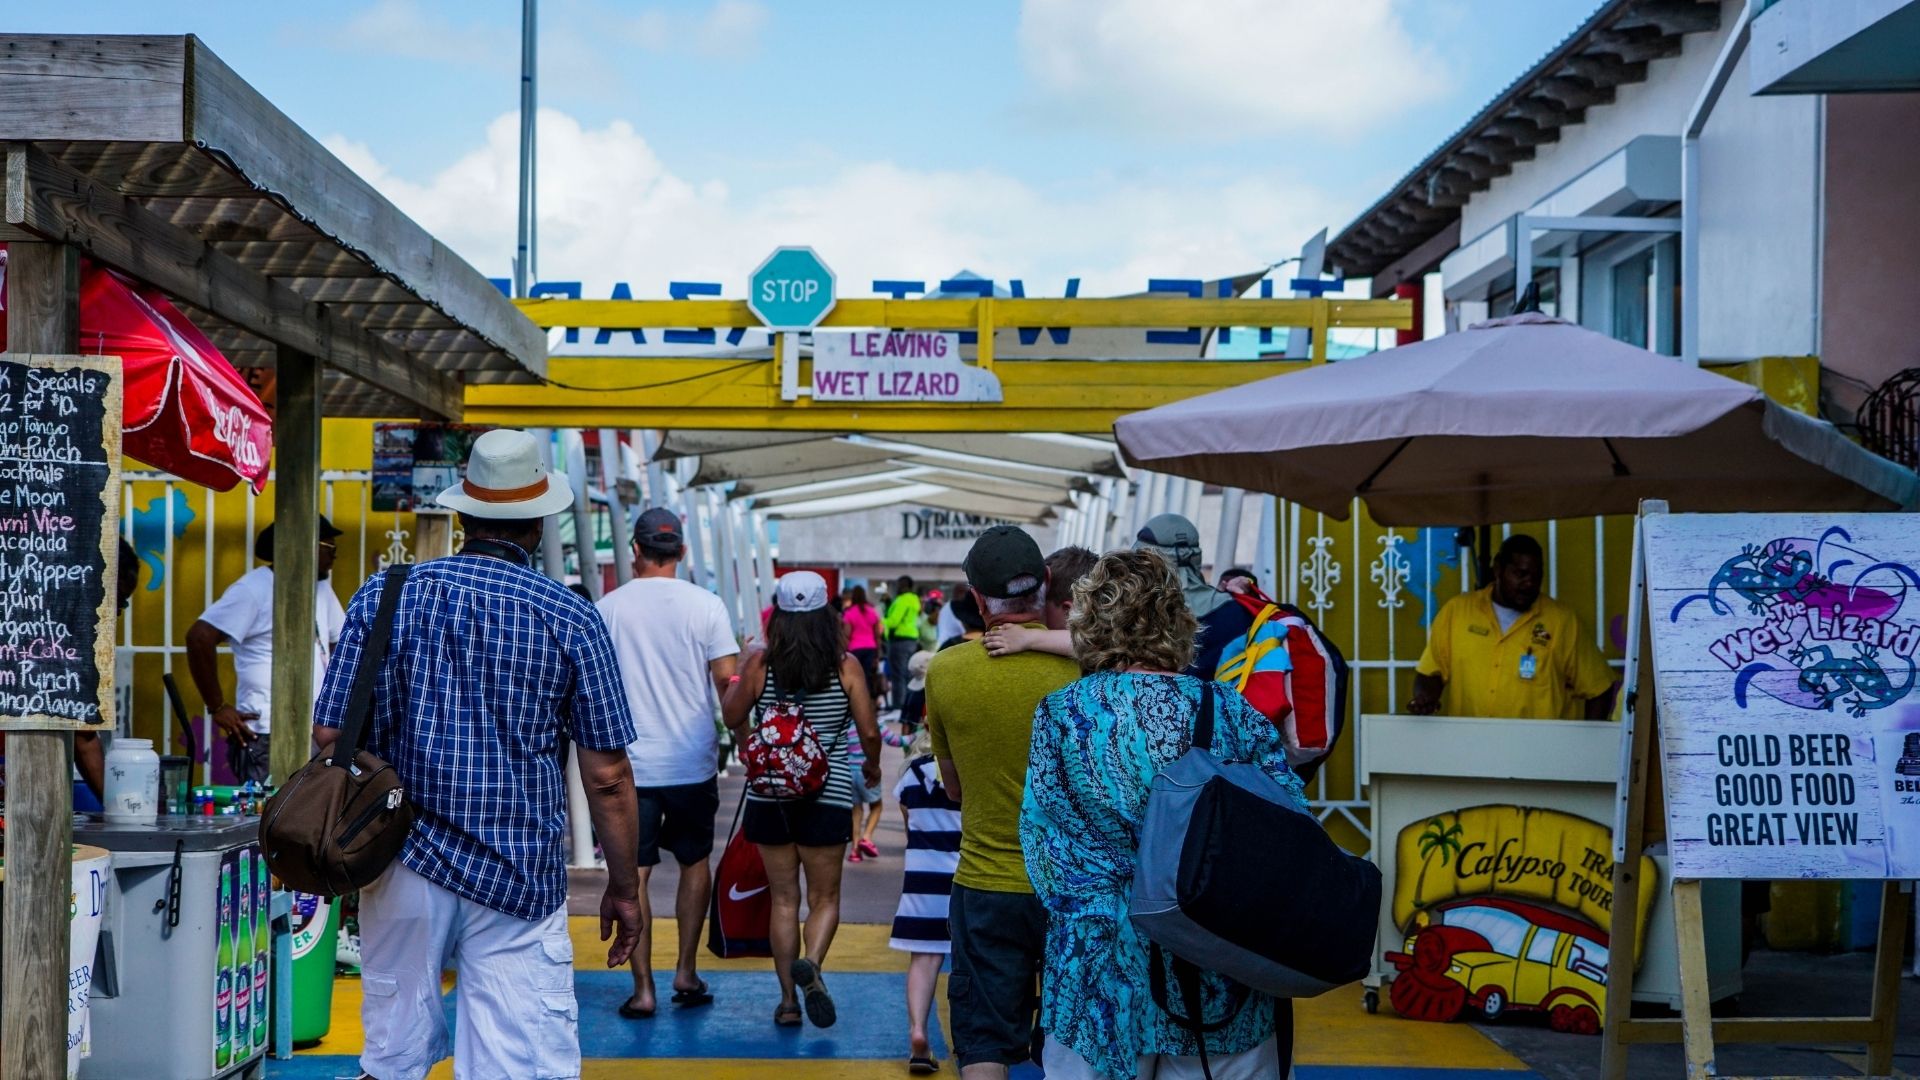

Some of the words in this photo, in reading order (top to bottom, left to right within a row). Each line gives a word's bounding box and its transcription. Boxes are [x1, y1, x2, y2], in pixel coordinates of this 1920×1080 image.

[761, 279, 819, 303] STOP
[850, 333, 947, 358] LEAVING
[27, 369, 96, 400] Specials
[815, 371, 869, 396] WET
[879, 371, 959, 396] LIZARD
[19, 393, 44, 414] for
[19, 415, 68, 448] Tango
[0, 461, 64, 484] ocktails
[15, 484, 65, 507] Moon
[32, 507, 76, 534] Vice
[24, 553, 93, 592] Ripper
[1769, 601, 1808, 622] The
[1708, 617, 1793, 670] Wet
[1806, 603, 1920, 658] Lizard
[1717, 734, 1781, 767] COLD
[1788, 733, 1853, 767] BEER
[1715, 773, 1783, 807] GOOD
[1790, 773, 1856, 806] FOOD
[124, 798, 142, 814] Tips
[1707, 813, 1788, 846] GREAT
[1794, 812, 1859, 846] VIEW
[1455, 838, 1566, 884] Calypso
[1580, 847, 1615, 882] TRA
[1568, 872, 1613, 912] TOUR
[68, 964, 92, 991] EER
